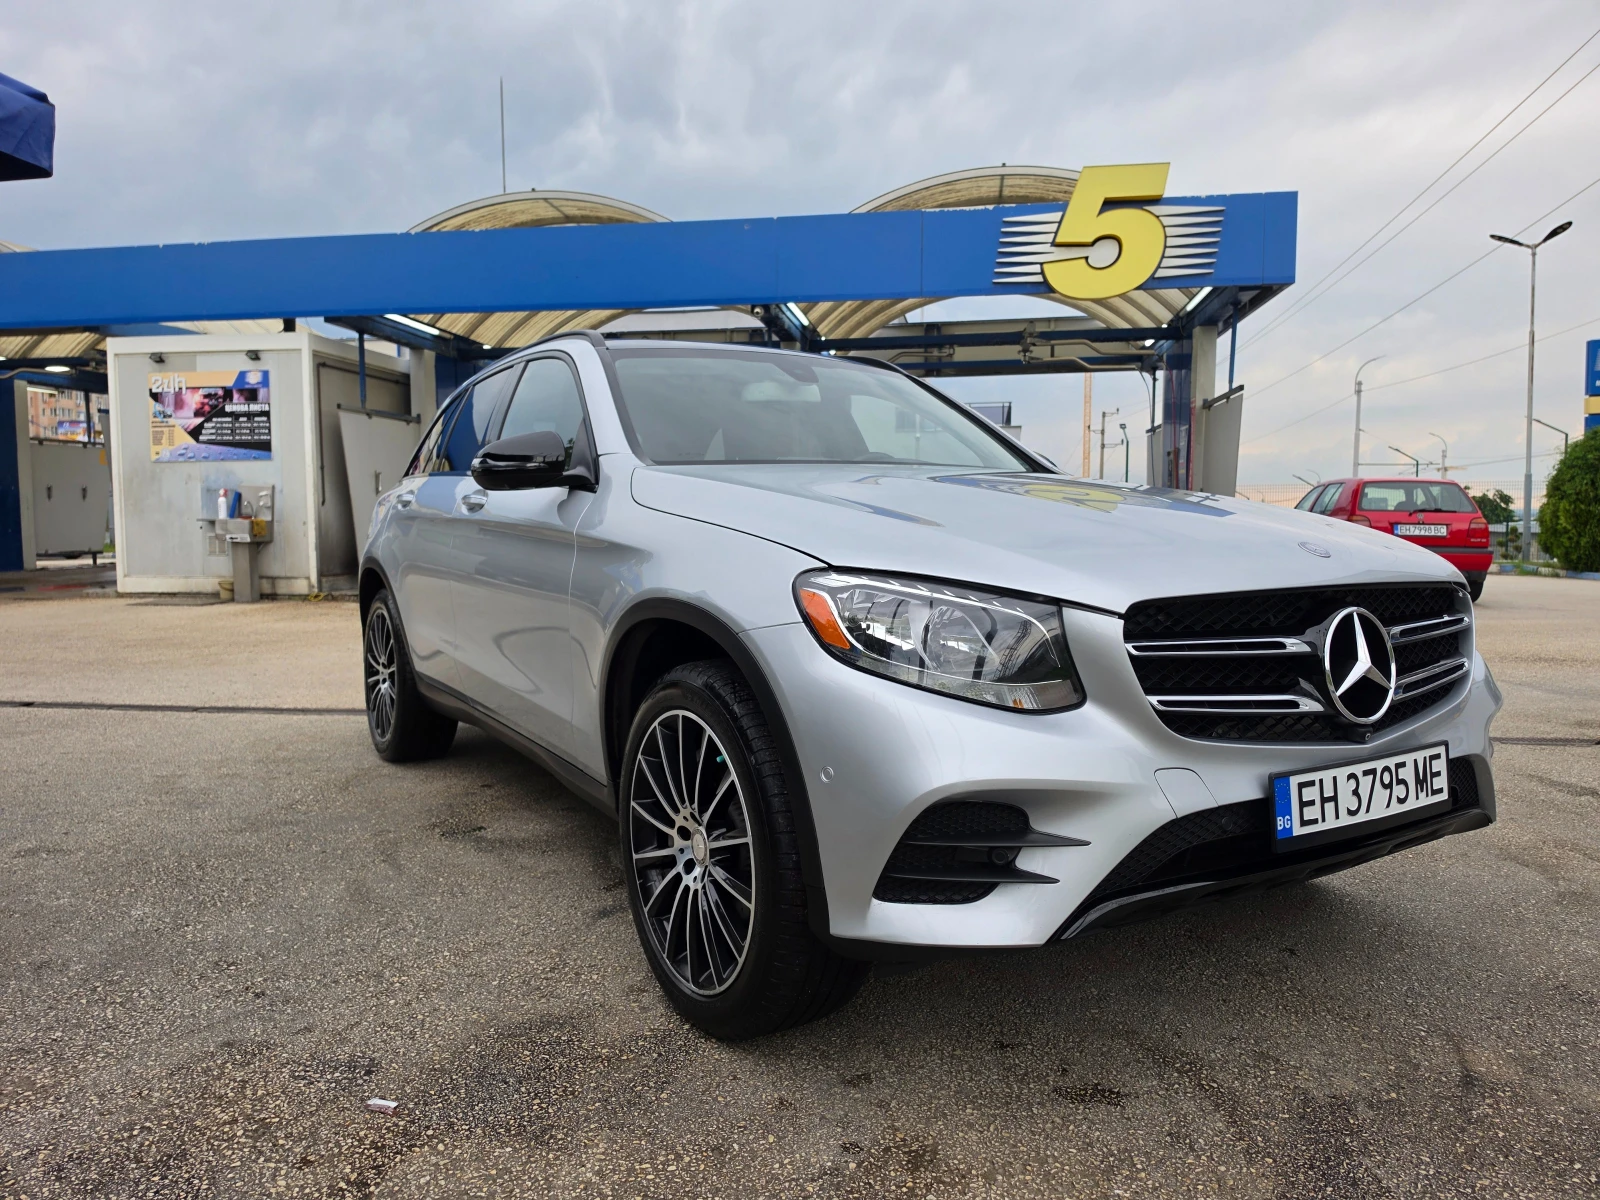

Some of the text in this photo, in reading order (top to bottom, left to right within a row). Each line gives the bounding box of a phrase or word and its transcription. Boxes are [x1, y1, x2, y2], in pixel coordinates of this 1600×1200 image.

[1042, 162, 1170, 300] 5
[1412, 526, 1433, 534] 7998
[1297, 752, 1444, 828] EH 3795 ME
[1276, 815, 1291, 831] BG
